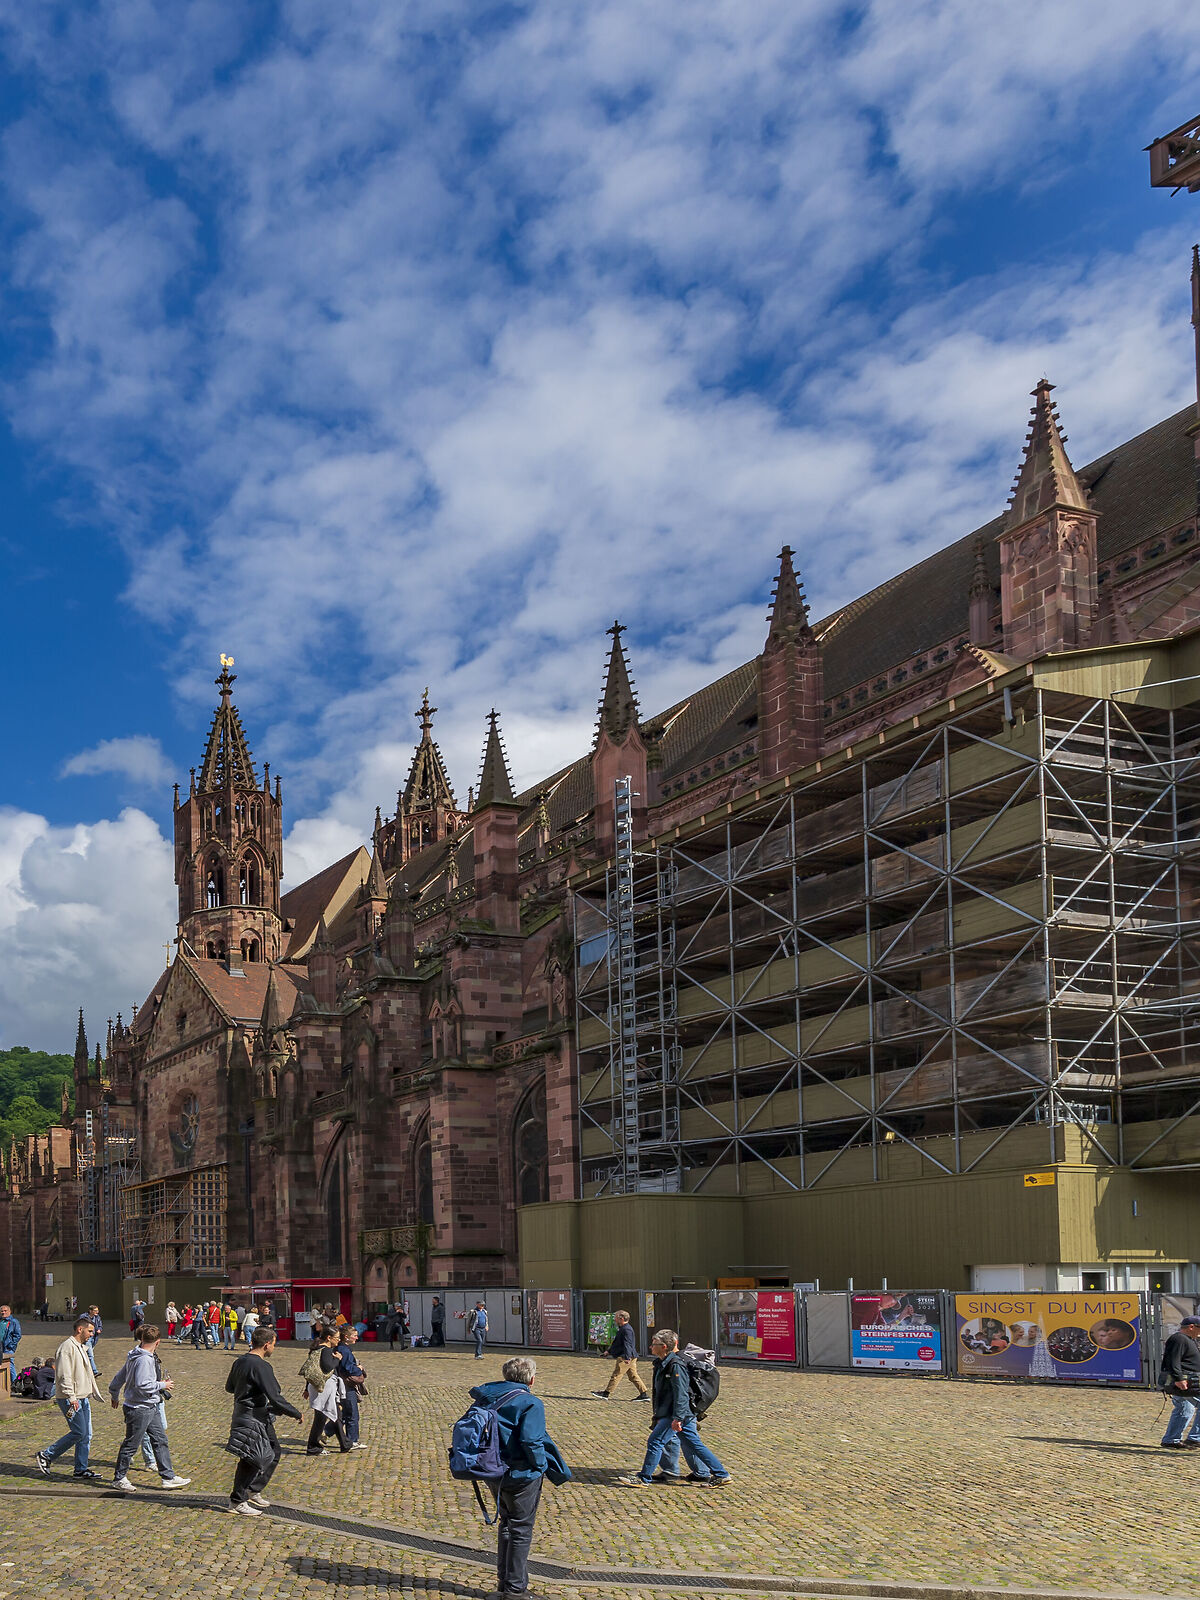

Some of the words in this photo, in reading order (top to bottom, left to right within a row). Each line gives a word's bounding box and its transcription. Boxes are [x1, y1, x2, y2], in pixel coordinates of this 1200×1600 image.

[968, 1301, 1037, 1314] SINGST
[1048, 1301, 1077, 1315] DU
[1084, 1301, 1132, 1315] MIT?
